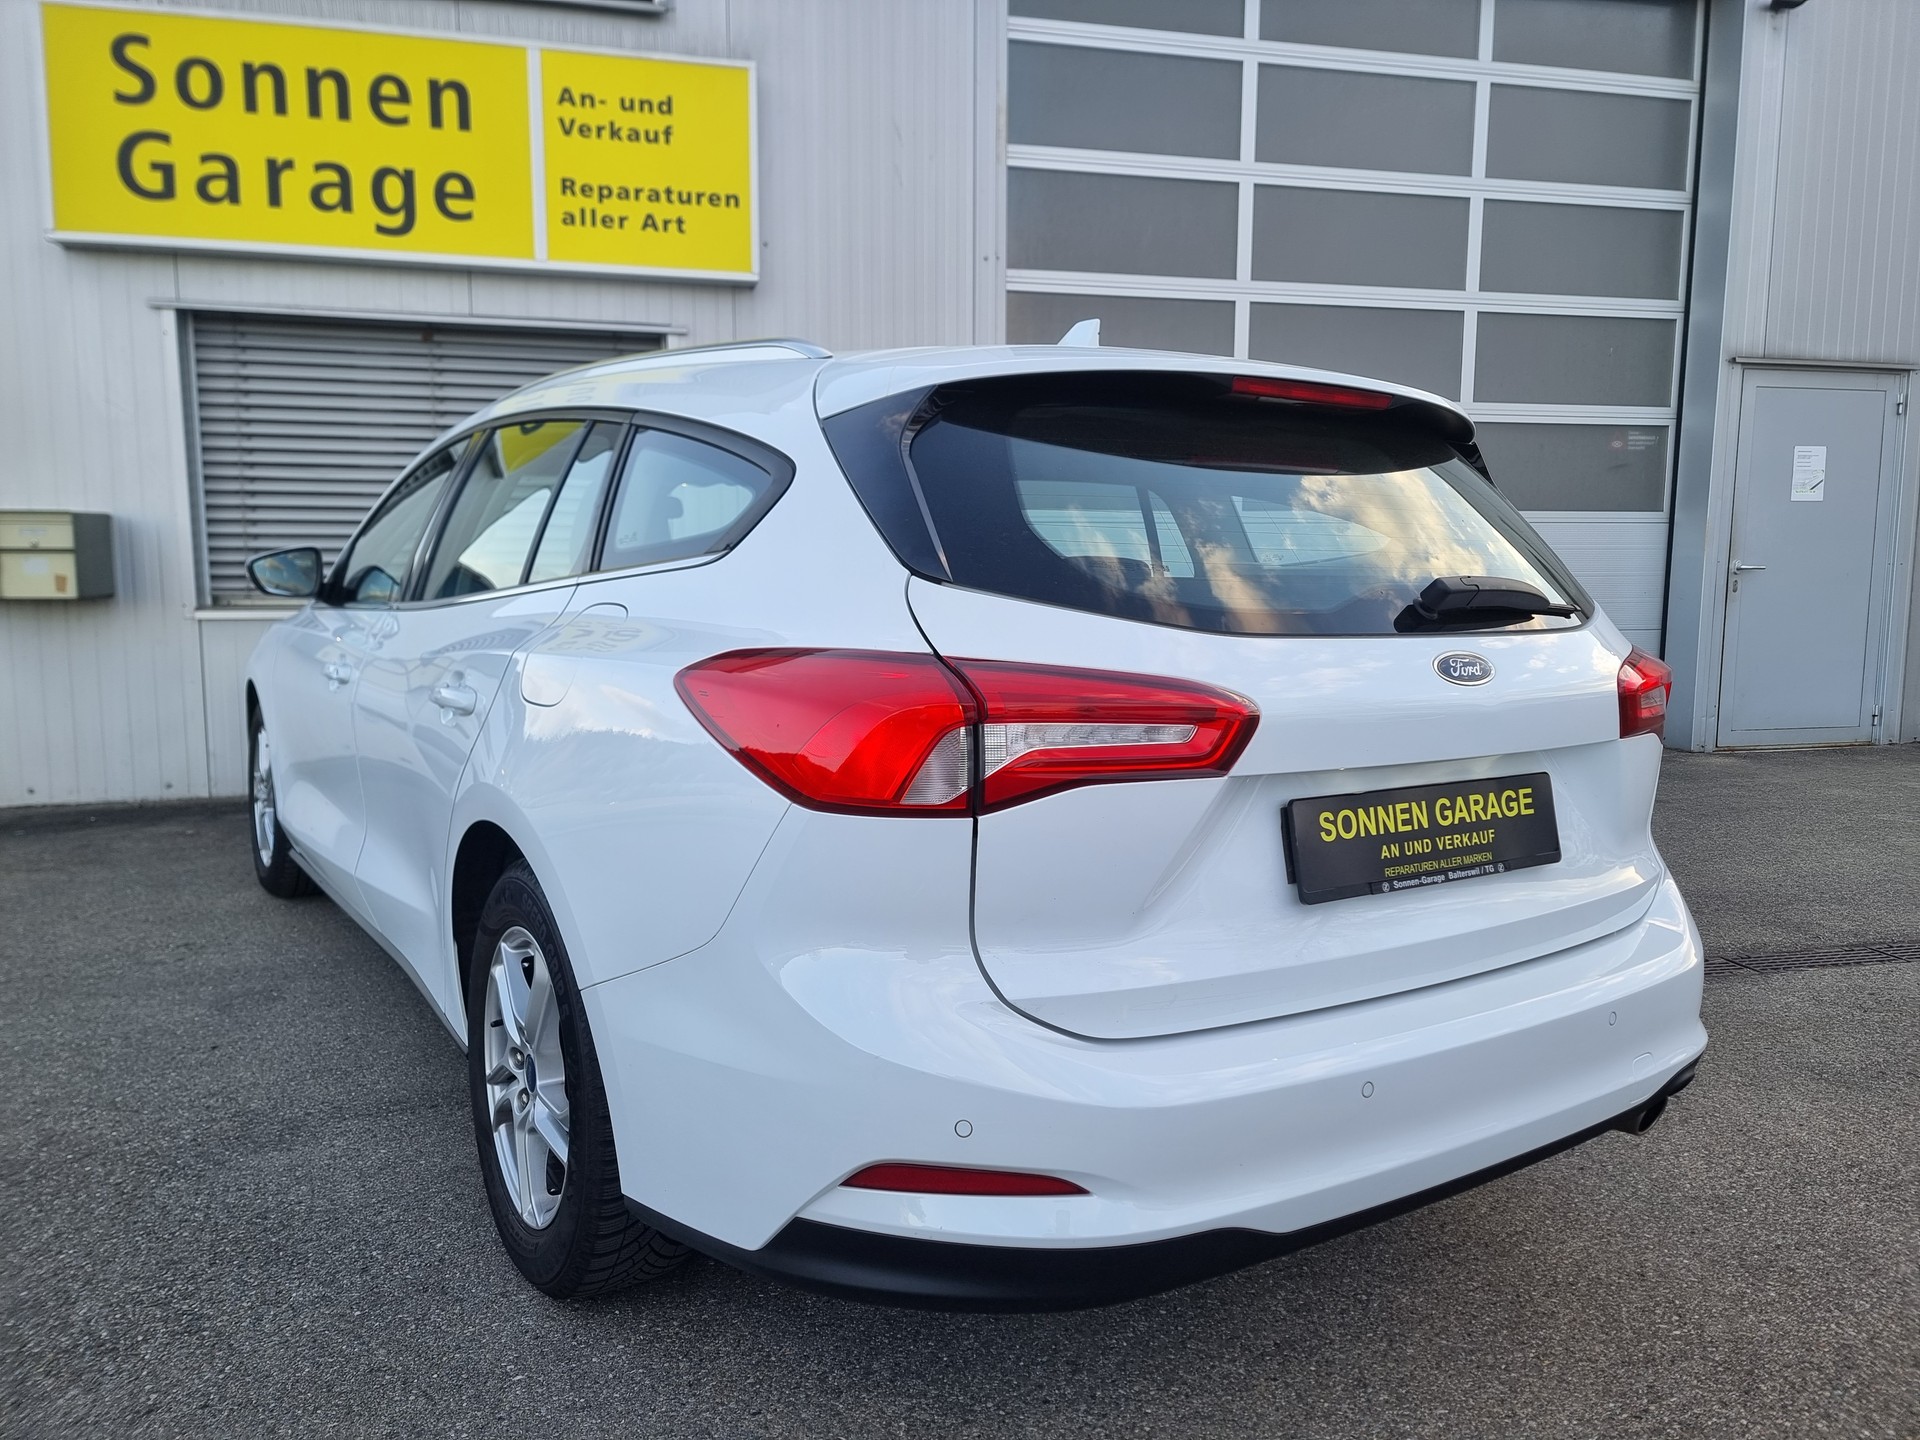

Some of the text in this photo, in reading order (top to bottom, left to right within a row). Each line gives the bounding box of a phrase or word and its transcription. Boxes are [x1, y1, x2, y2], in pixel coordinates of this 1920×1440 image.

[109, 32, 474, 133] Sonnen
[557, 86, 674, 116] An- und
[558, 116, 674, 145] Verkauf
[115, 129, 477, 237] Garage
[560, 176, 742, 209] Reparaturen
[561, 207, 686, 234] aller Art
[1449, 658, 1483, 677] Ford
[1318, 787, 1535, 842] SONNEN GARAGE
[1380, 829, 1496, 859] AN UND VERKAUF
[1384, 851, 1493, 878] REPARATUREN ALLER MARKEN
[1393, 873, 1446, 889] Sonnen-Garage
[1485, 864, 1495, 873] TG
